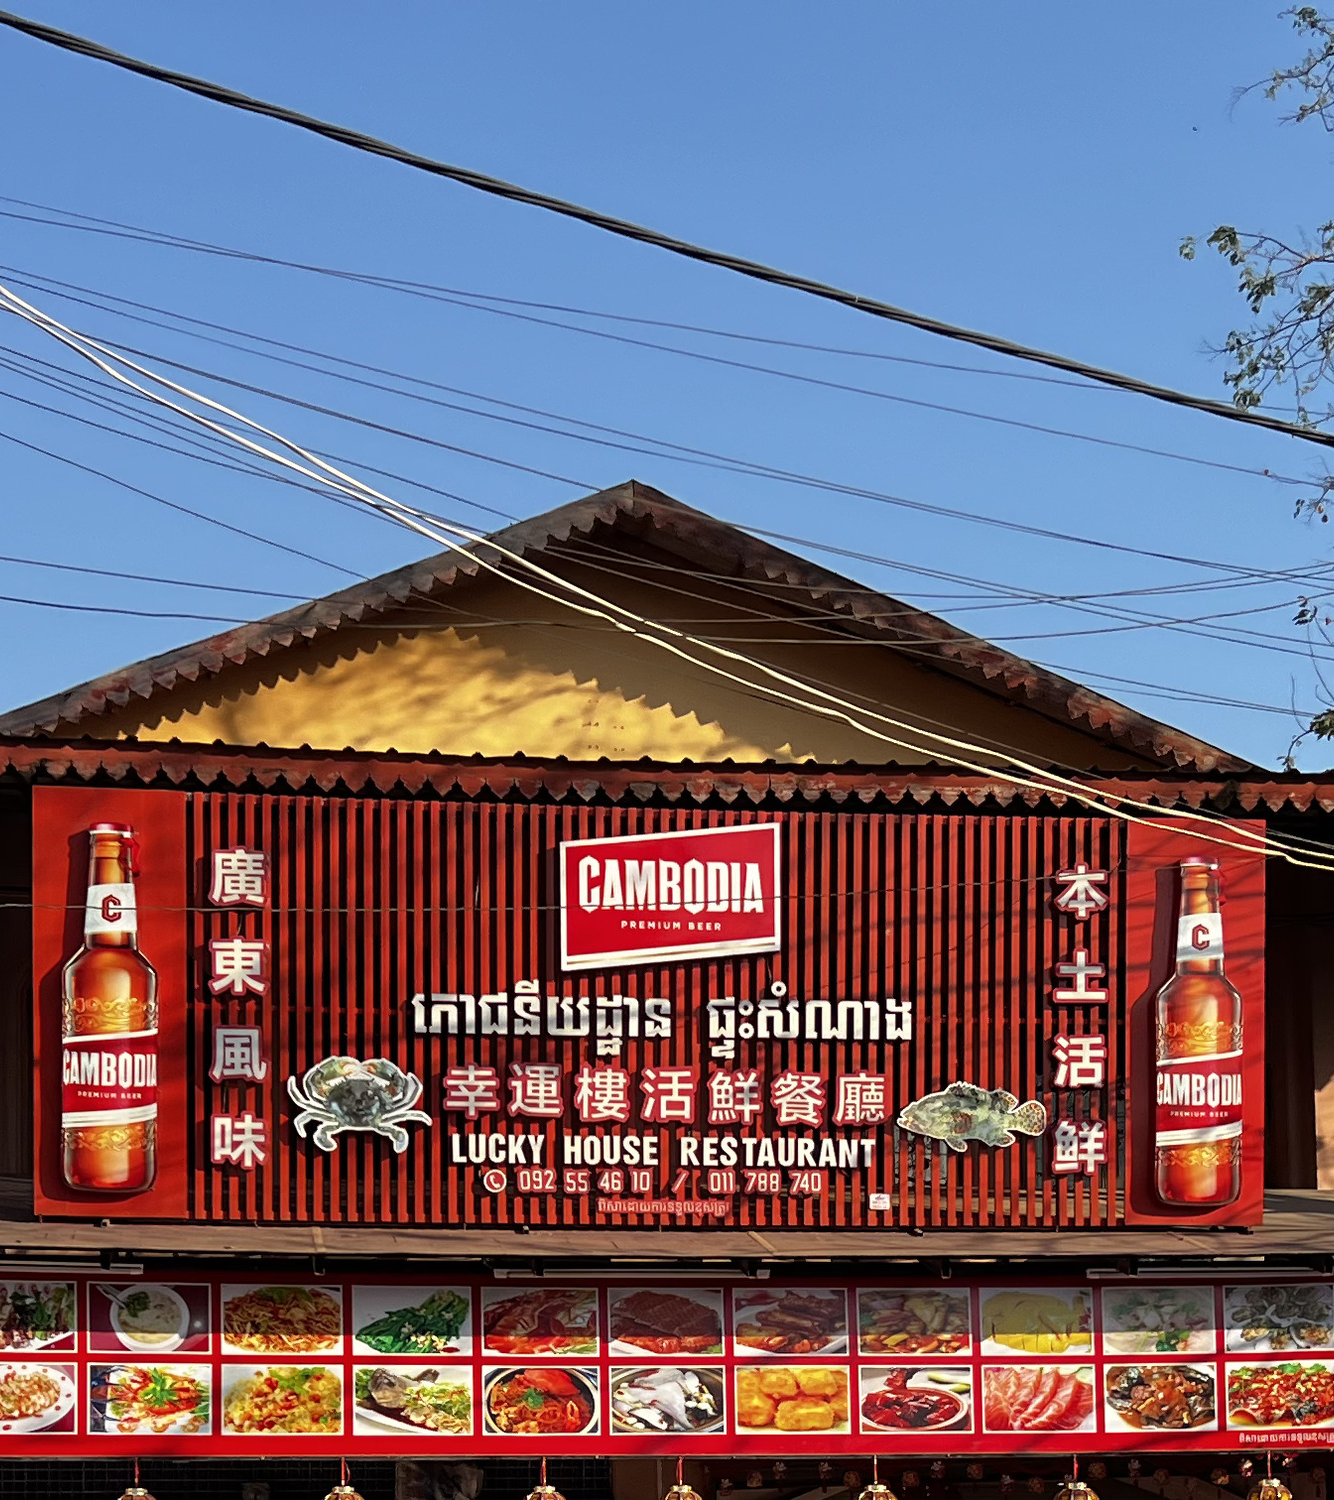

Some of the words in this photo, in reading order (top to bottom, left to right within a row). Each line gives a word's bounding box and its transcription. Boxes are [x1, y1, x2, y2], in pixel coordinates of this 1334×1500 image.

[578, 854, 765, 915] CAMBODIA
[101, 894, 122, 923] C
[620, 920, 682, 930] PREMIUM
[687, 921, 722, 931] BEER
[1191, 923, 1210, 951] C
[210, 848, 268, 1169] 廣東風味
[1054, 864, 1108, 1174] 本土活鲜
[62, 1048, 158, 1090] CAMBODIA
[444, 1063, 886, 1126] 幸運樓活鮮餐廳
[1156, 1071, 1243, 1109] CAMBODIA
[451, 1132, 545, 1165] LUCKY
[563, 1134, 659, 1166] HOUSE
[680, 1136, 877, 1168] RESTAURANT
[519, 1169, 555, 1191] 092
[565, 1171, 589, 1192] 55
[599, 1170, 623, 1192] 46
[631, 1170, 651, 1192] 10
[710, 1172, 735, 1193] 011
[747, 1172, 781, 1193] 788
[791, 1172, 822, 1193] 740
